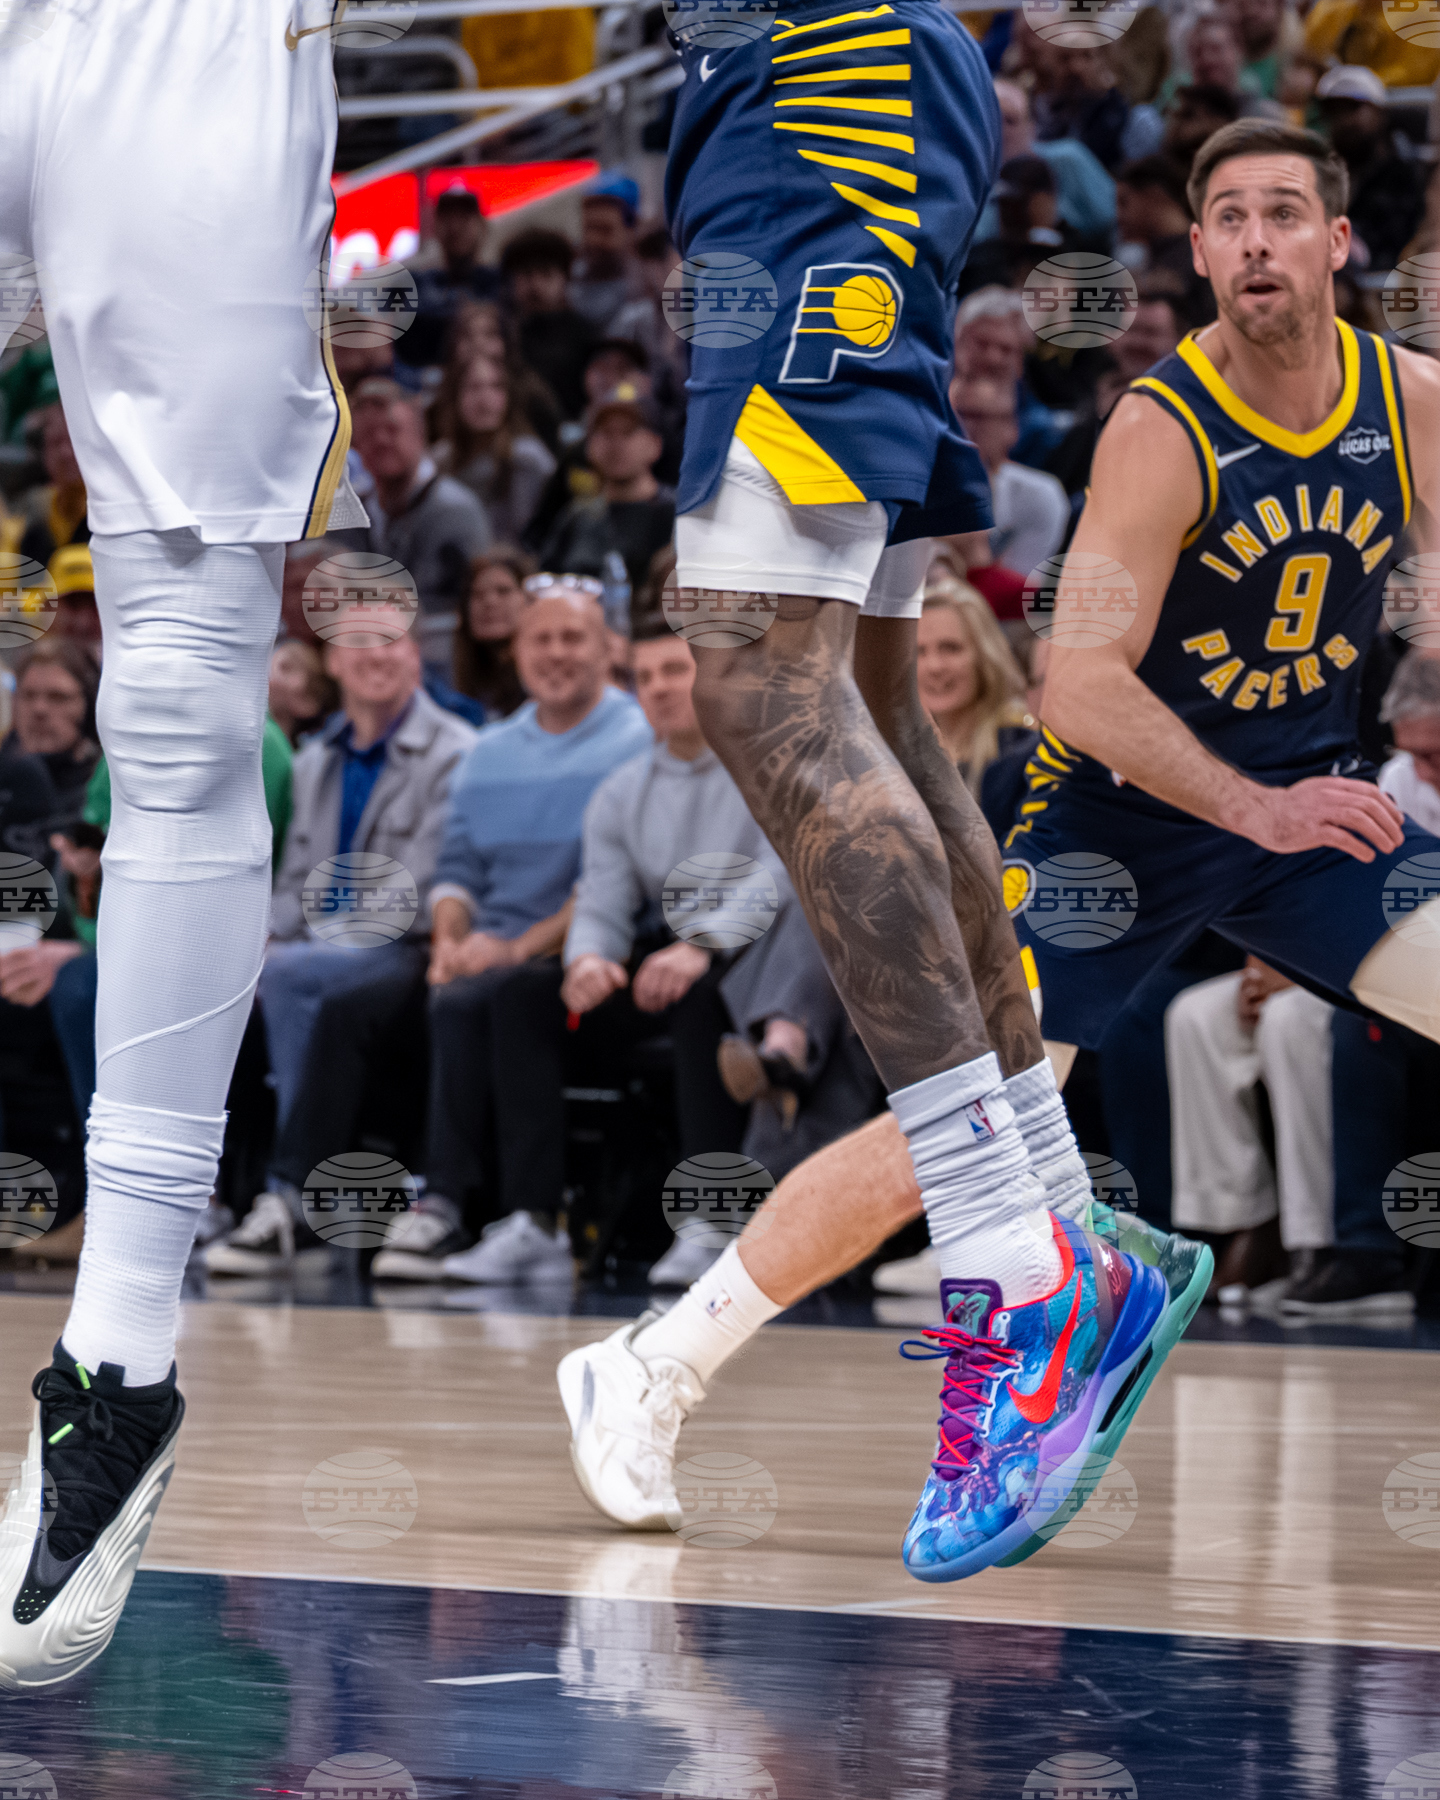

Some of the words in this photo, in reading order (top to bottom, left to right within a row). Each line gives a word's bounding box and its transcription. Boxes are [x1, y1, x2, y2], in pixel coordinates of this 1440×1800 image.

[1199, 484, 1393, 583] INDIANA
[1264, 552, 1332, 652] 9
[1181, 629, 1360, 711] PACERS
